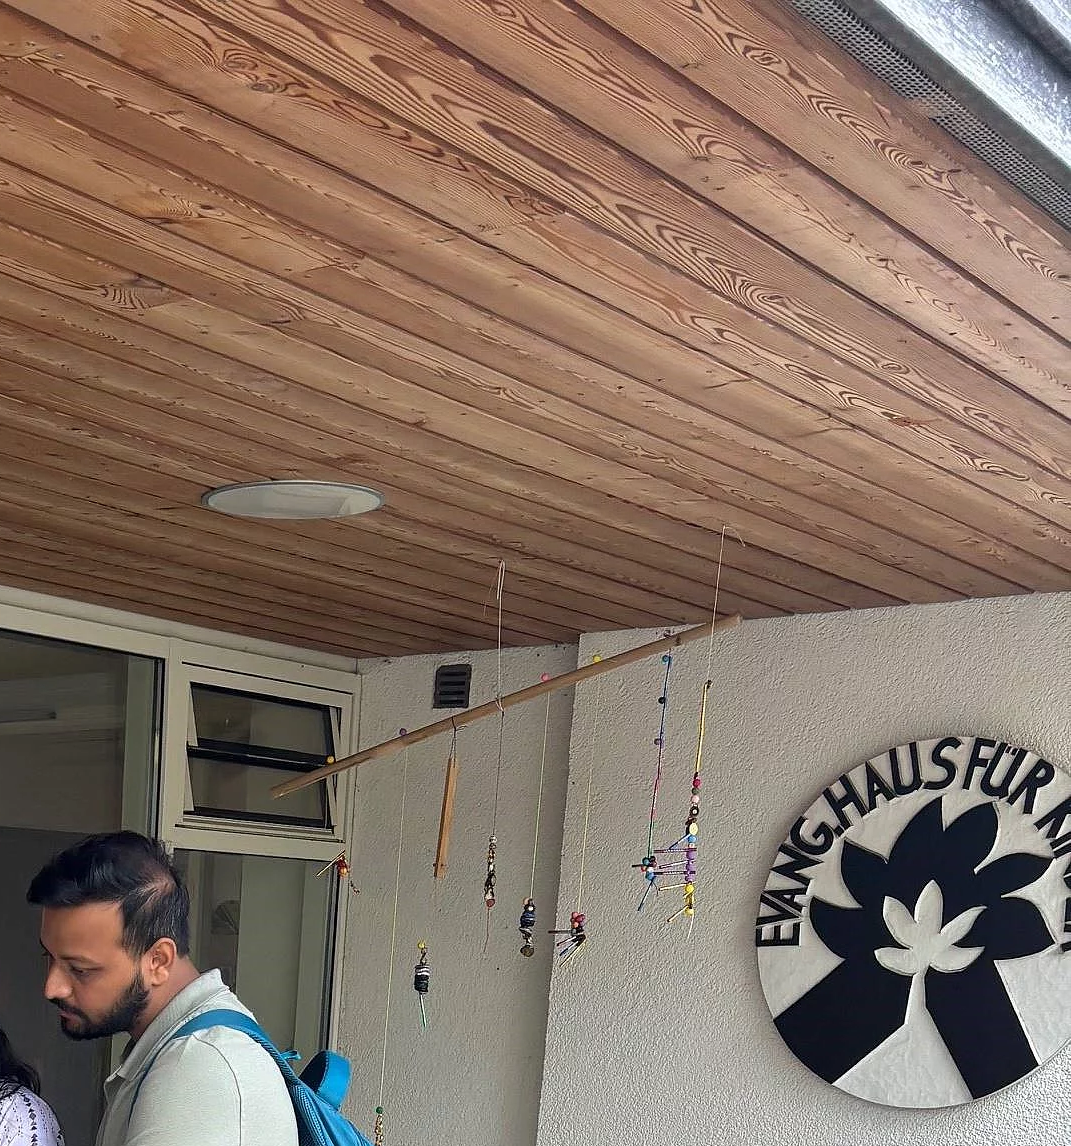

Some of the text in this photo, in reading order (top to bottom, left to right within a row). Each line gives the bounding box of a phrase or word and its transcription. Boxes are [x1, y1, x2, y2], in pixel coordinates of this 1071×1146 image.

[756, 736, 1056, 947] EVANG. HAUS FÜR
